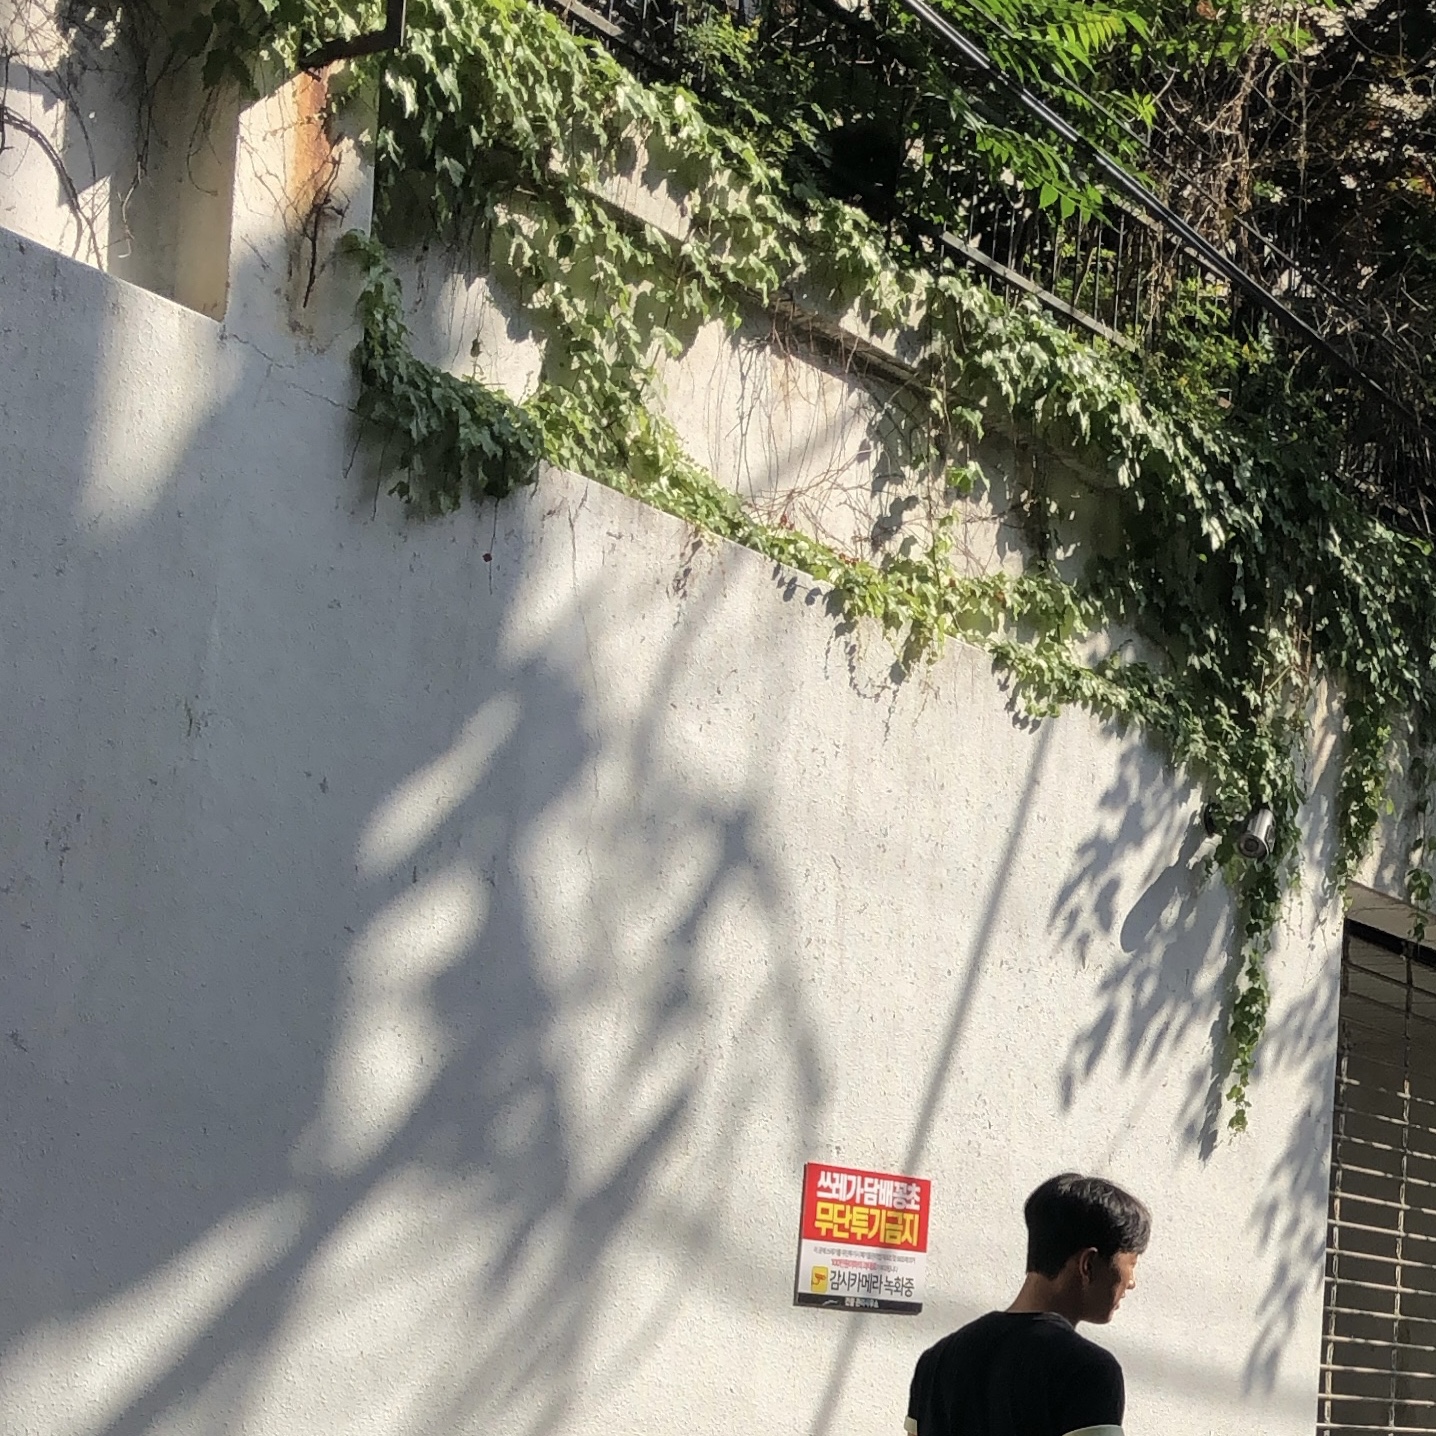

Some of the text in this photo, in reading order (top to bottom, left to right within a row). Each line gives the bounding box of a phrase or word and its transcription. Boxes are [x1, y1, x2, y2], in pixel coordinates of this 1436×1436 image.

[814, 1201, 920, 1247] 무단투기금지
[829, 1269, 915, 1298] 감시카메라 녹화중
